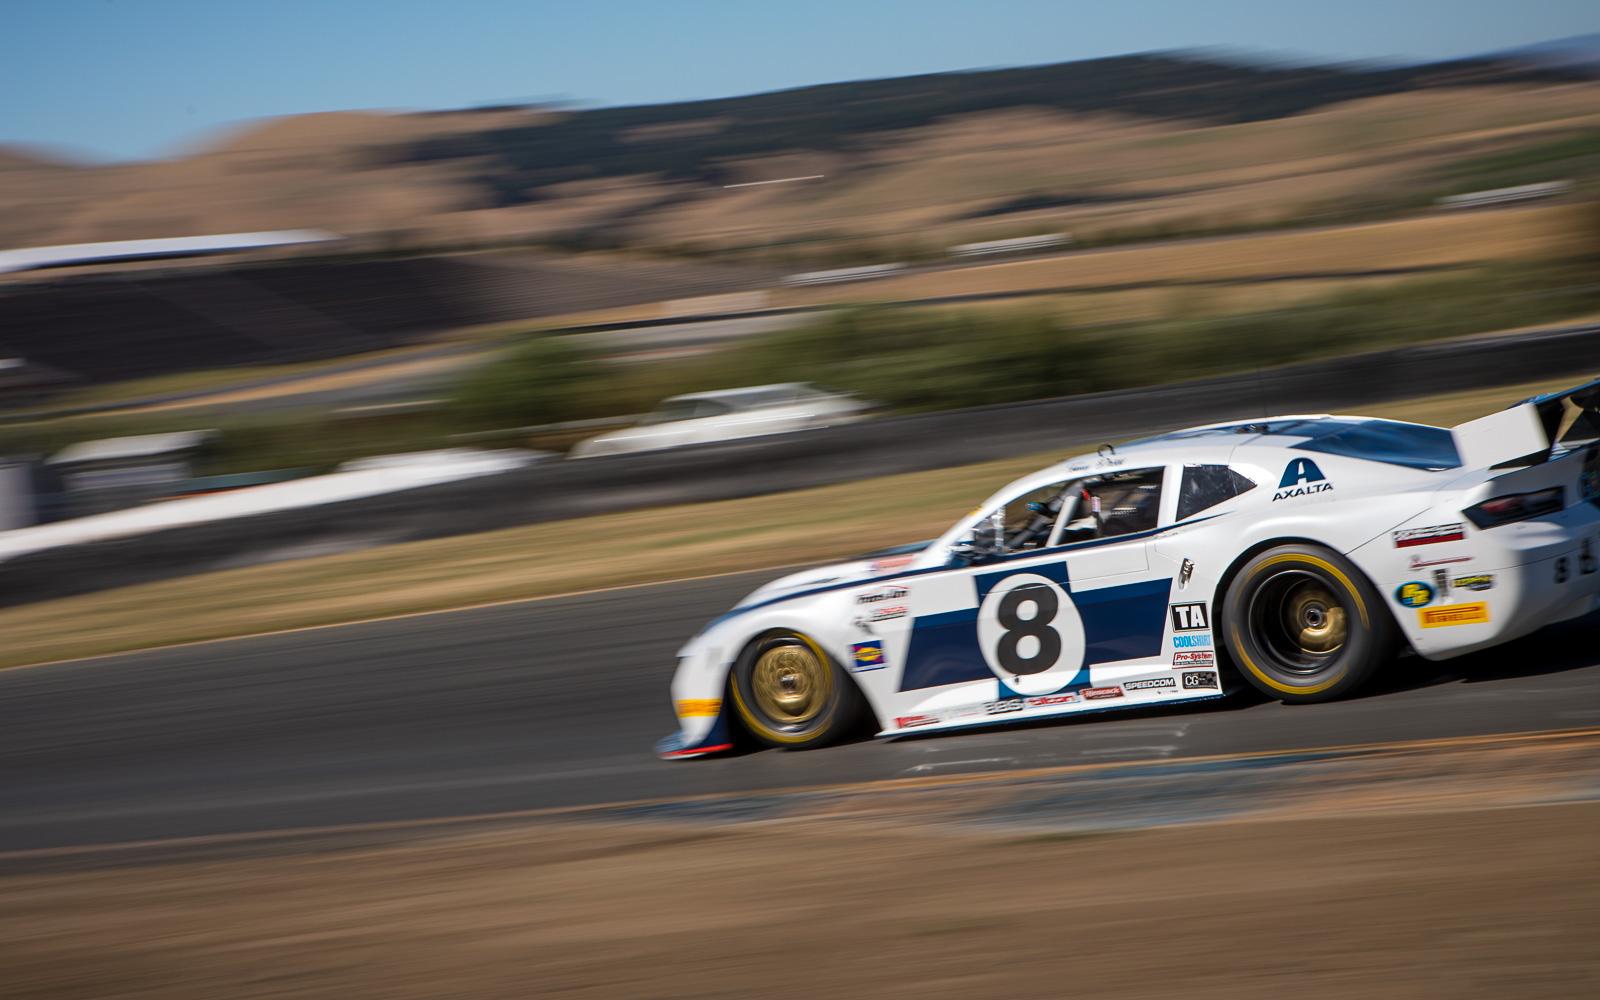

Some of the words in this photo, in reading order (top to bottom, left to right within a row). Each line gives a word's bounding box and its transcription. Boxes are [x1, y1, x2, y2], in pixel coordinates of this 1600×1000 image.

[1272, 482, 1334, 502] AXALTA
[1174, 604, 1206, 628] TA
[996, 583, 1061, 676] 8
[1172, 634, 1211, 648] COOLSHIRT
[1175, 652, 1213, 662] Pro-System
[1124, 678, 1175, 690] SPEEDCOM
[1185, 675, 1199, 686] CG
